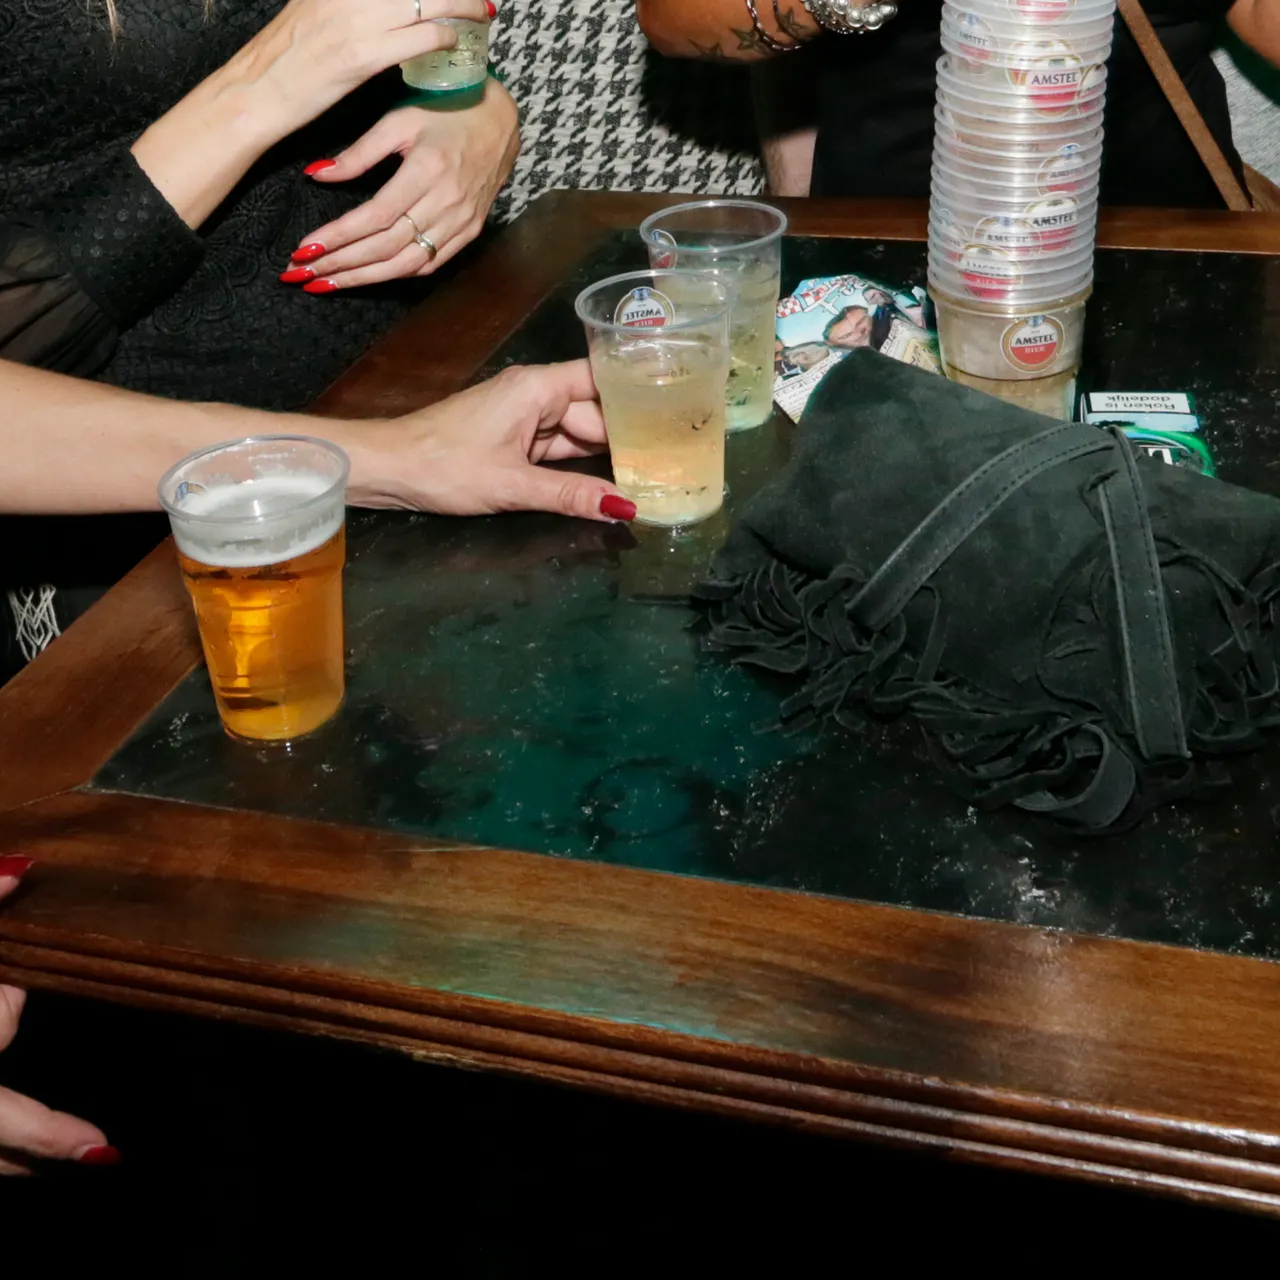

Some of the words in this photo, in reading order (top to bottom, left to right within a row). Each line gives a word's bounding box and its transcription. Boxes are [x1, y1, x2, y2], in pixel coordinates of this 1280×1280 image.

[1032, 72, 1077, 85] AMSTEL
[1033, 211, 1073, 227] AMSTEL
[1015, 334, 1054, 345] AMSTEL
[1106, 394, 1171, 403] dodelijk
[1123, 402, 1176, 410] Roken
